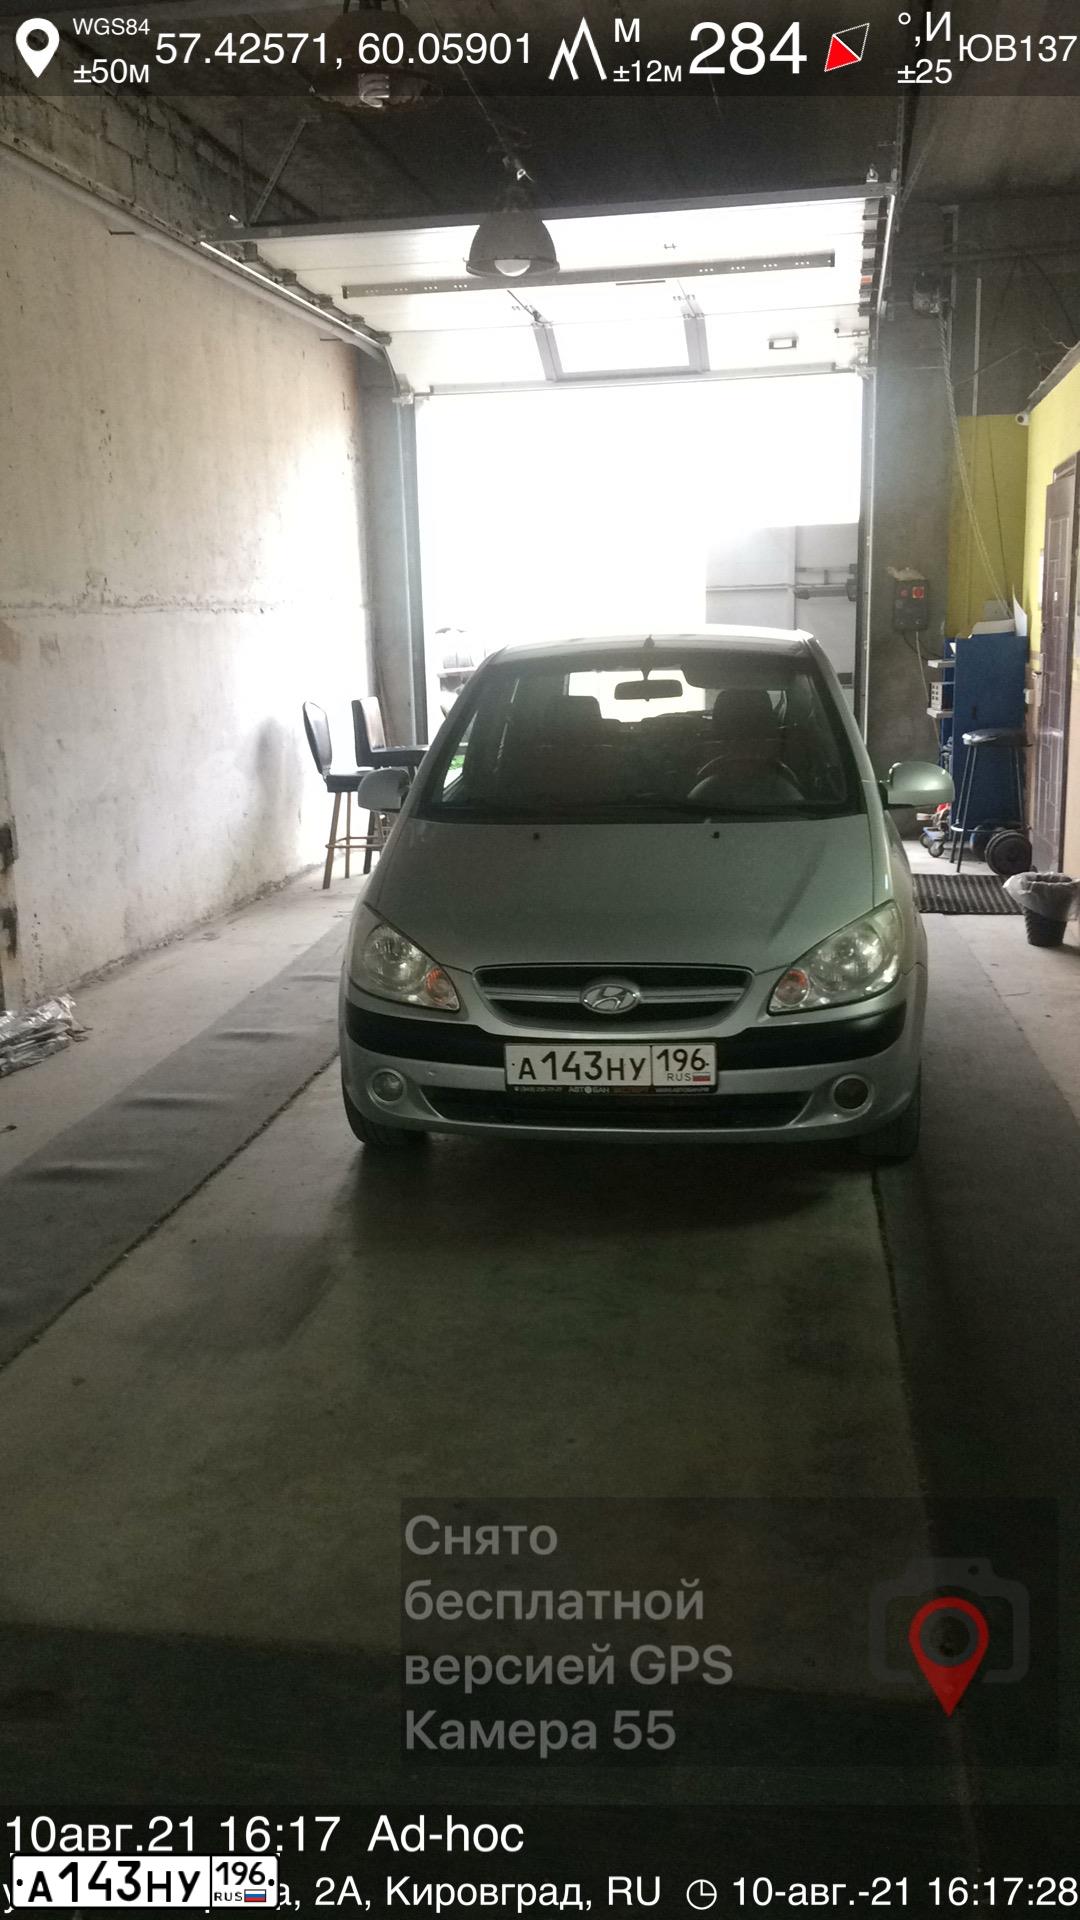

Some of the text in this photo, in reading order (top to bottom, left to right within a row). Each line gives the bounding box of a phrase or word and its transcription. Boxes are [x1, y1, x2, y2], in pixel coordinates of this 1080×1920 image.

[518, 1048, 705, 1081] А143НУ 196
[667, 1072, 691, 1082] RUS
